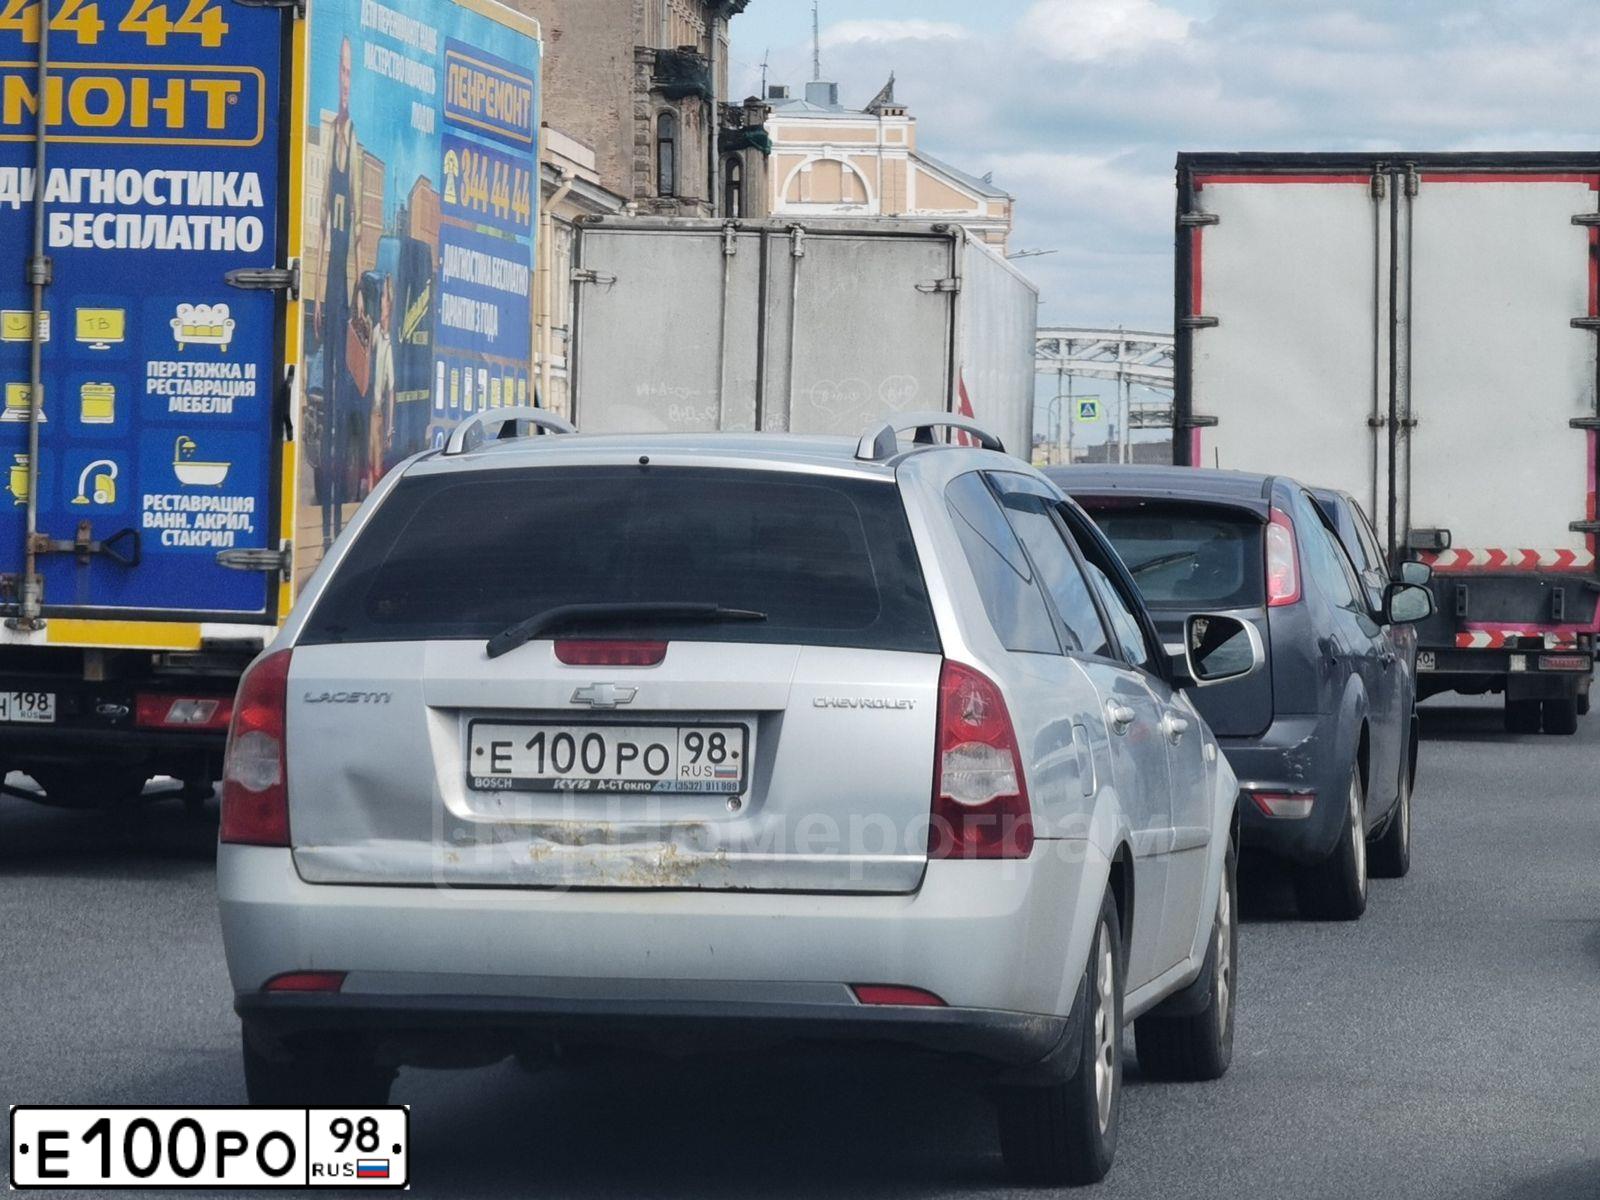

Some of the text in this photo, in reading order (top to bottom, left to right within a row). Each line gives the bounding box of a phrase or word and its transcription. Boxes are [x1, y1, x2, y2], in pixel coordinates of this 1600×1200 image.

[0, 166, 264, 210] ДИАГНОСТИКА
[461, 148, 531, 226] 344 44 44
[48, 212, 264, 253] БЕСПЛАТНО
[147, 361, 256, 380] ПЕРЕТЯЖКА И
[146, 378, 256, 399] РЕСТАВРАЦИЯ
[168, 396, 233, 414] МЕБЕЛИ
[143, 494, 255, 517] РЕСТАВРАЦИЯ
[143, 511, 254, 533] ВАНН. АКРИЛ,
[161, 529, 235, 547] СТАКРИЛ
[14, 692, 49, 711] 198
[304, 691, 392, 704] LACETTI
[812, 696, 917, 710] CHEVROLET
[684, 731, 727, 764] 98
[680, 765, 713, 778] RUS
[474, 778, 512, 789] BOSCH
